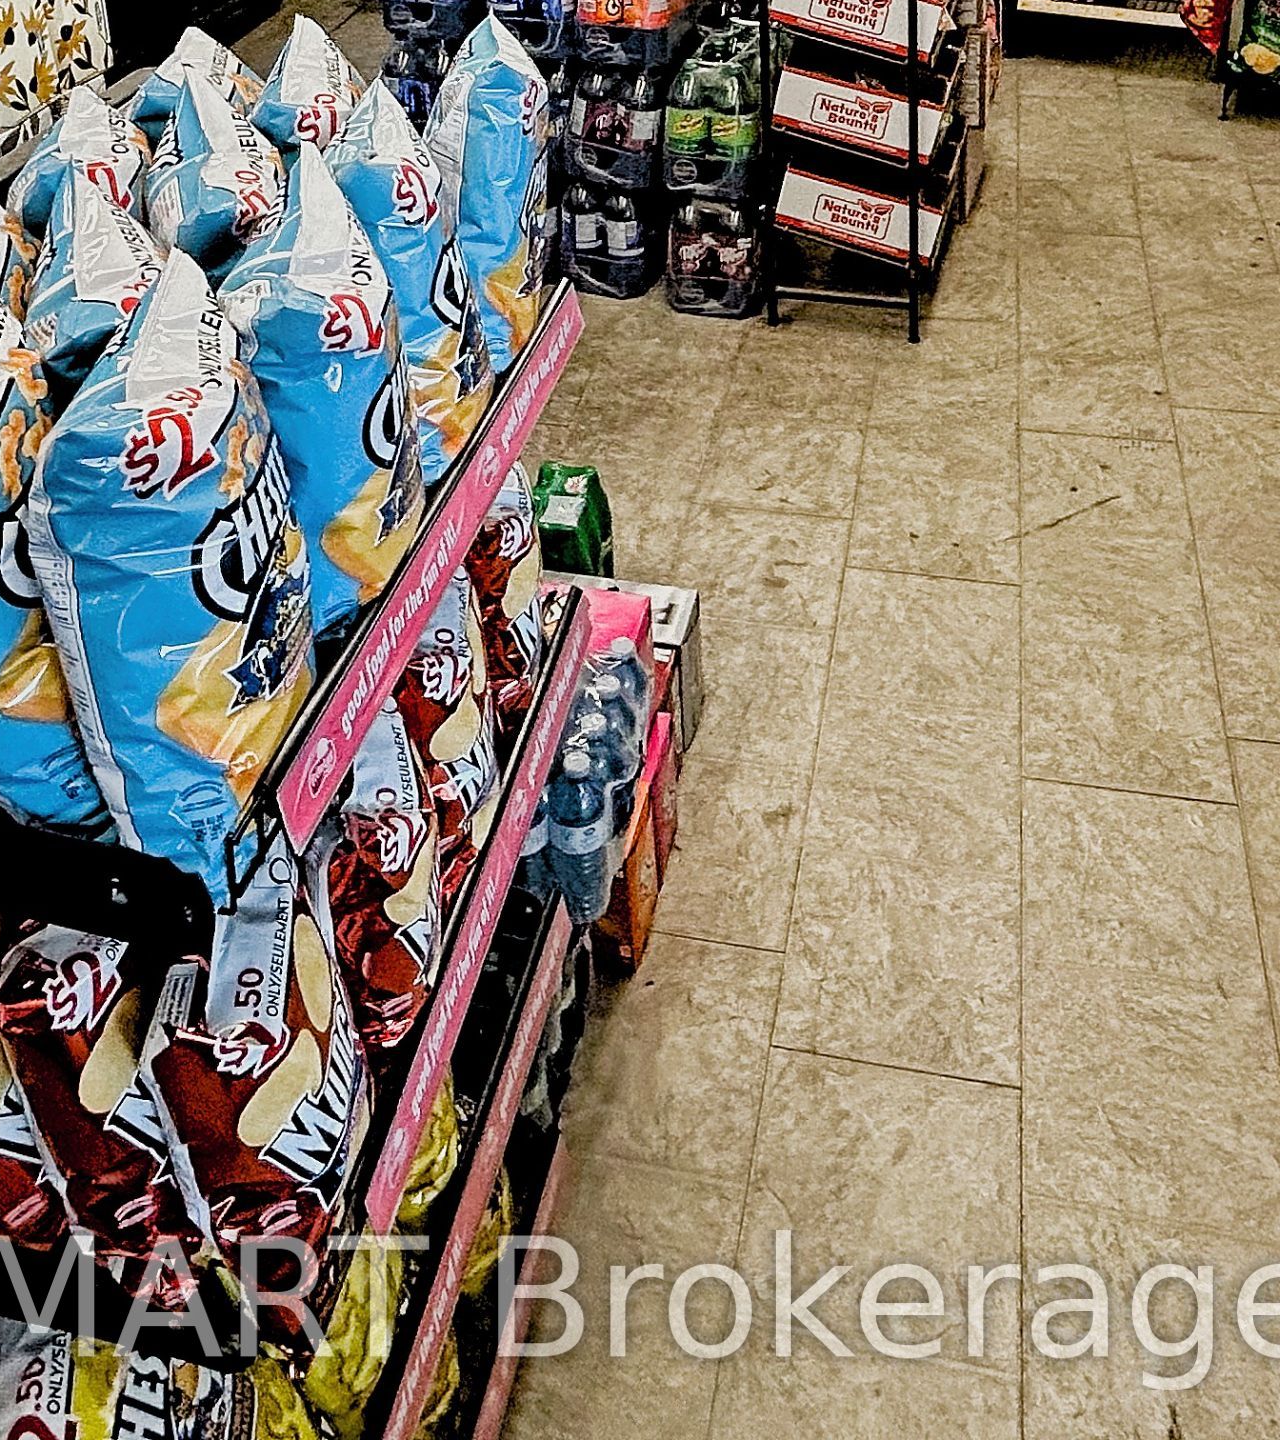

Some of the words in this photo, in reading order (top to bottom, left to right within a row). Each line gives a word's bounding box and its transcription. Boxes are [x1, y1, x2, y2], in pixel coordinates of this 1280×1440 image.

[826, 7, 879, 31] Bounty
[827, 112, 878, 135] Bounty
[830, 212, 880, 235] Bounty
[339, 676, 369, 736] good
[365, 630, 393, 689] food
[387, 602, 410, 655] for
[406, 585, 425, 626] the
[263, 896, 290, 1017] ONLY/SEULEMENT
